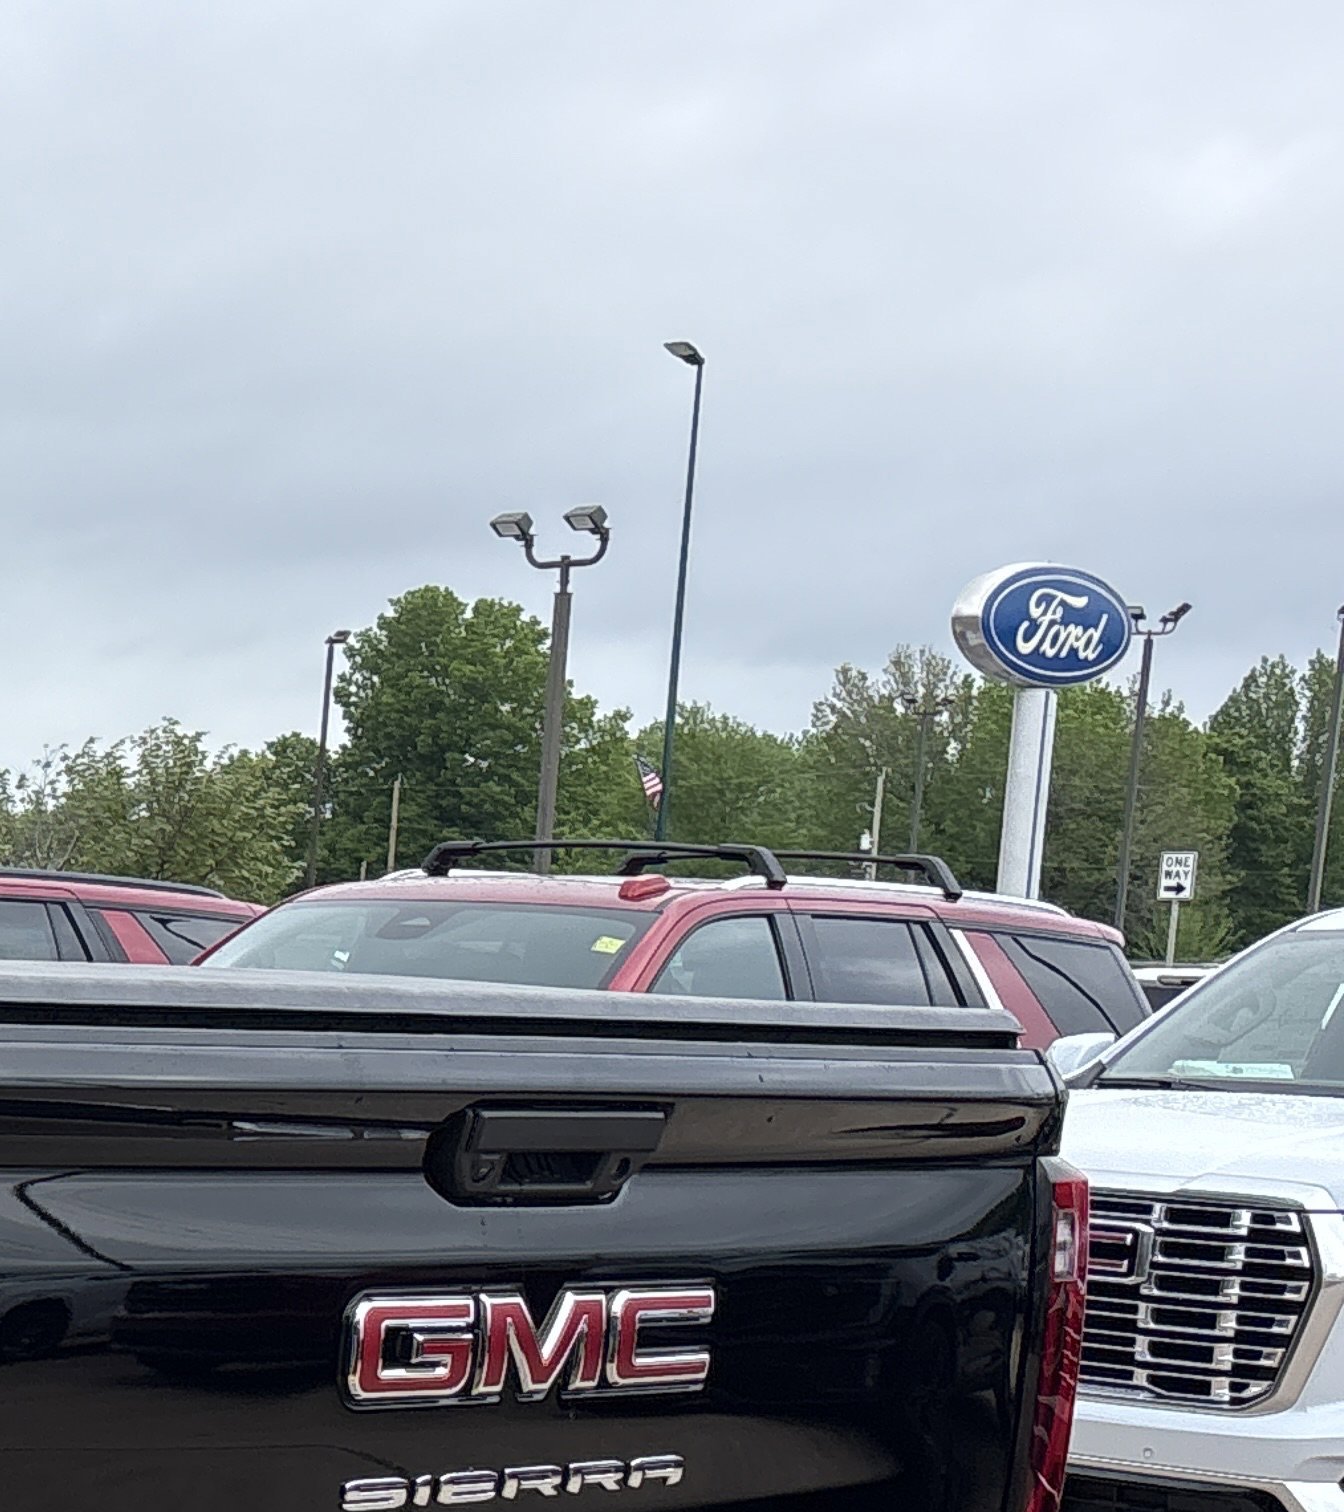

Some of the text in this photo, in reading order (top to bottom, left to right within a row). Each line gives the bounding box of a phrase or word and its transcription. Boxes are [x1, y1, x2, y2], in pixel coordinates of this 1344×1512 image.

[1016, 588, 1109, 661] Ford
[1164, 870, 1191, 880] WAY
[1166, 857, 1191, 868] ONE
[346, 1284, 714, 1407] GMC
[340, 1455, 685, 1511] SIERRA
